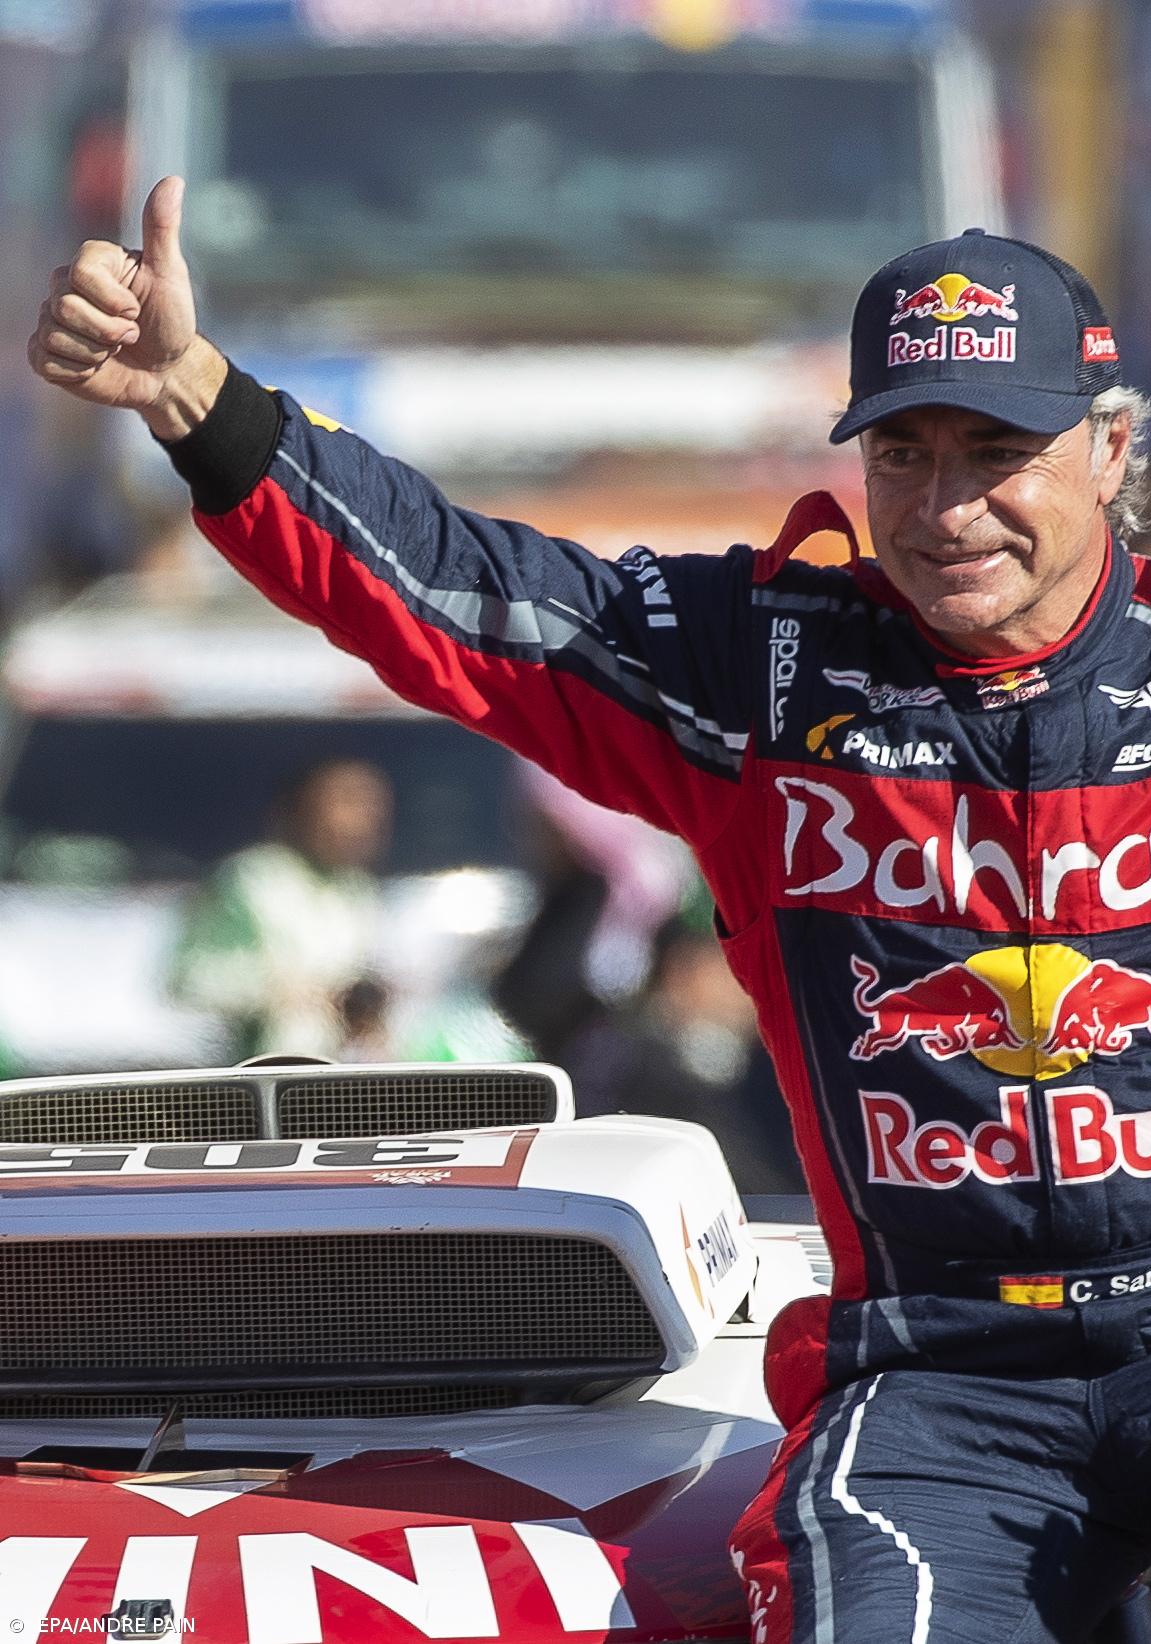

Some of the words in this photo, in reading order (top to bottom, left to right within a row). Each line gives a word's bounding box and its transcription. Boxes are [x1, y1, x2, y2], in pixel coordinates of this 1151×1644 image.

[887, 325, 947, 367] Red
[951, 326, 1017, 362] Bull
[841, 730, 958, 770] PRIMAX
[858, 1084, 1041, 1190] Red
[1069, 1280, 1100, 1303] C.
